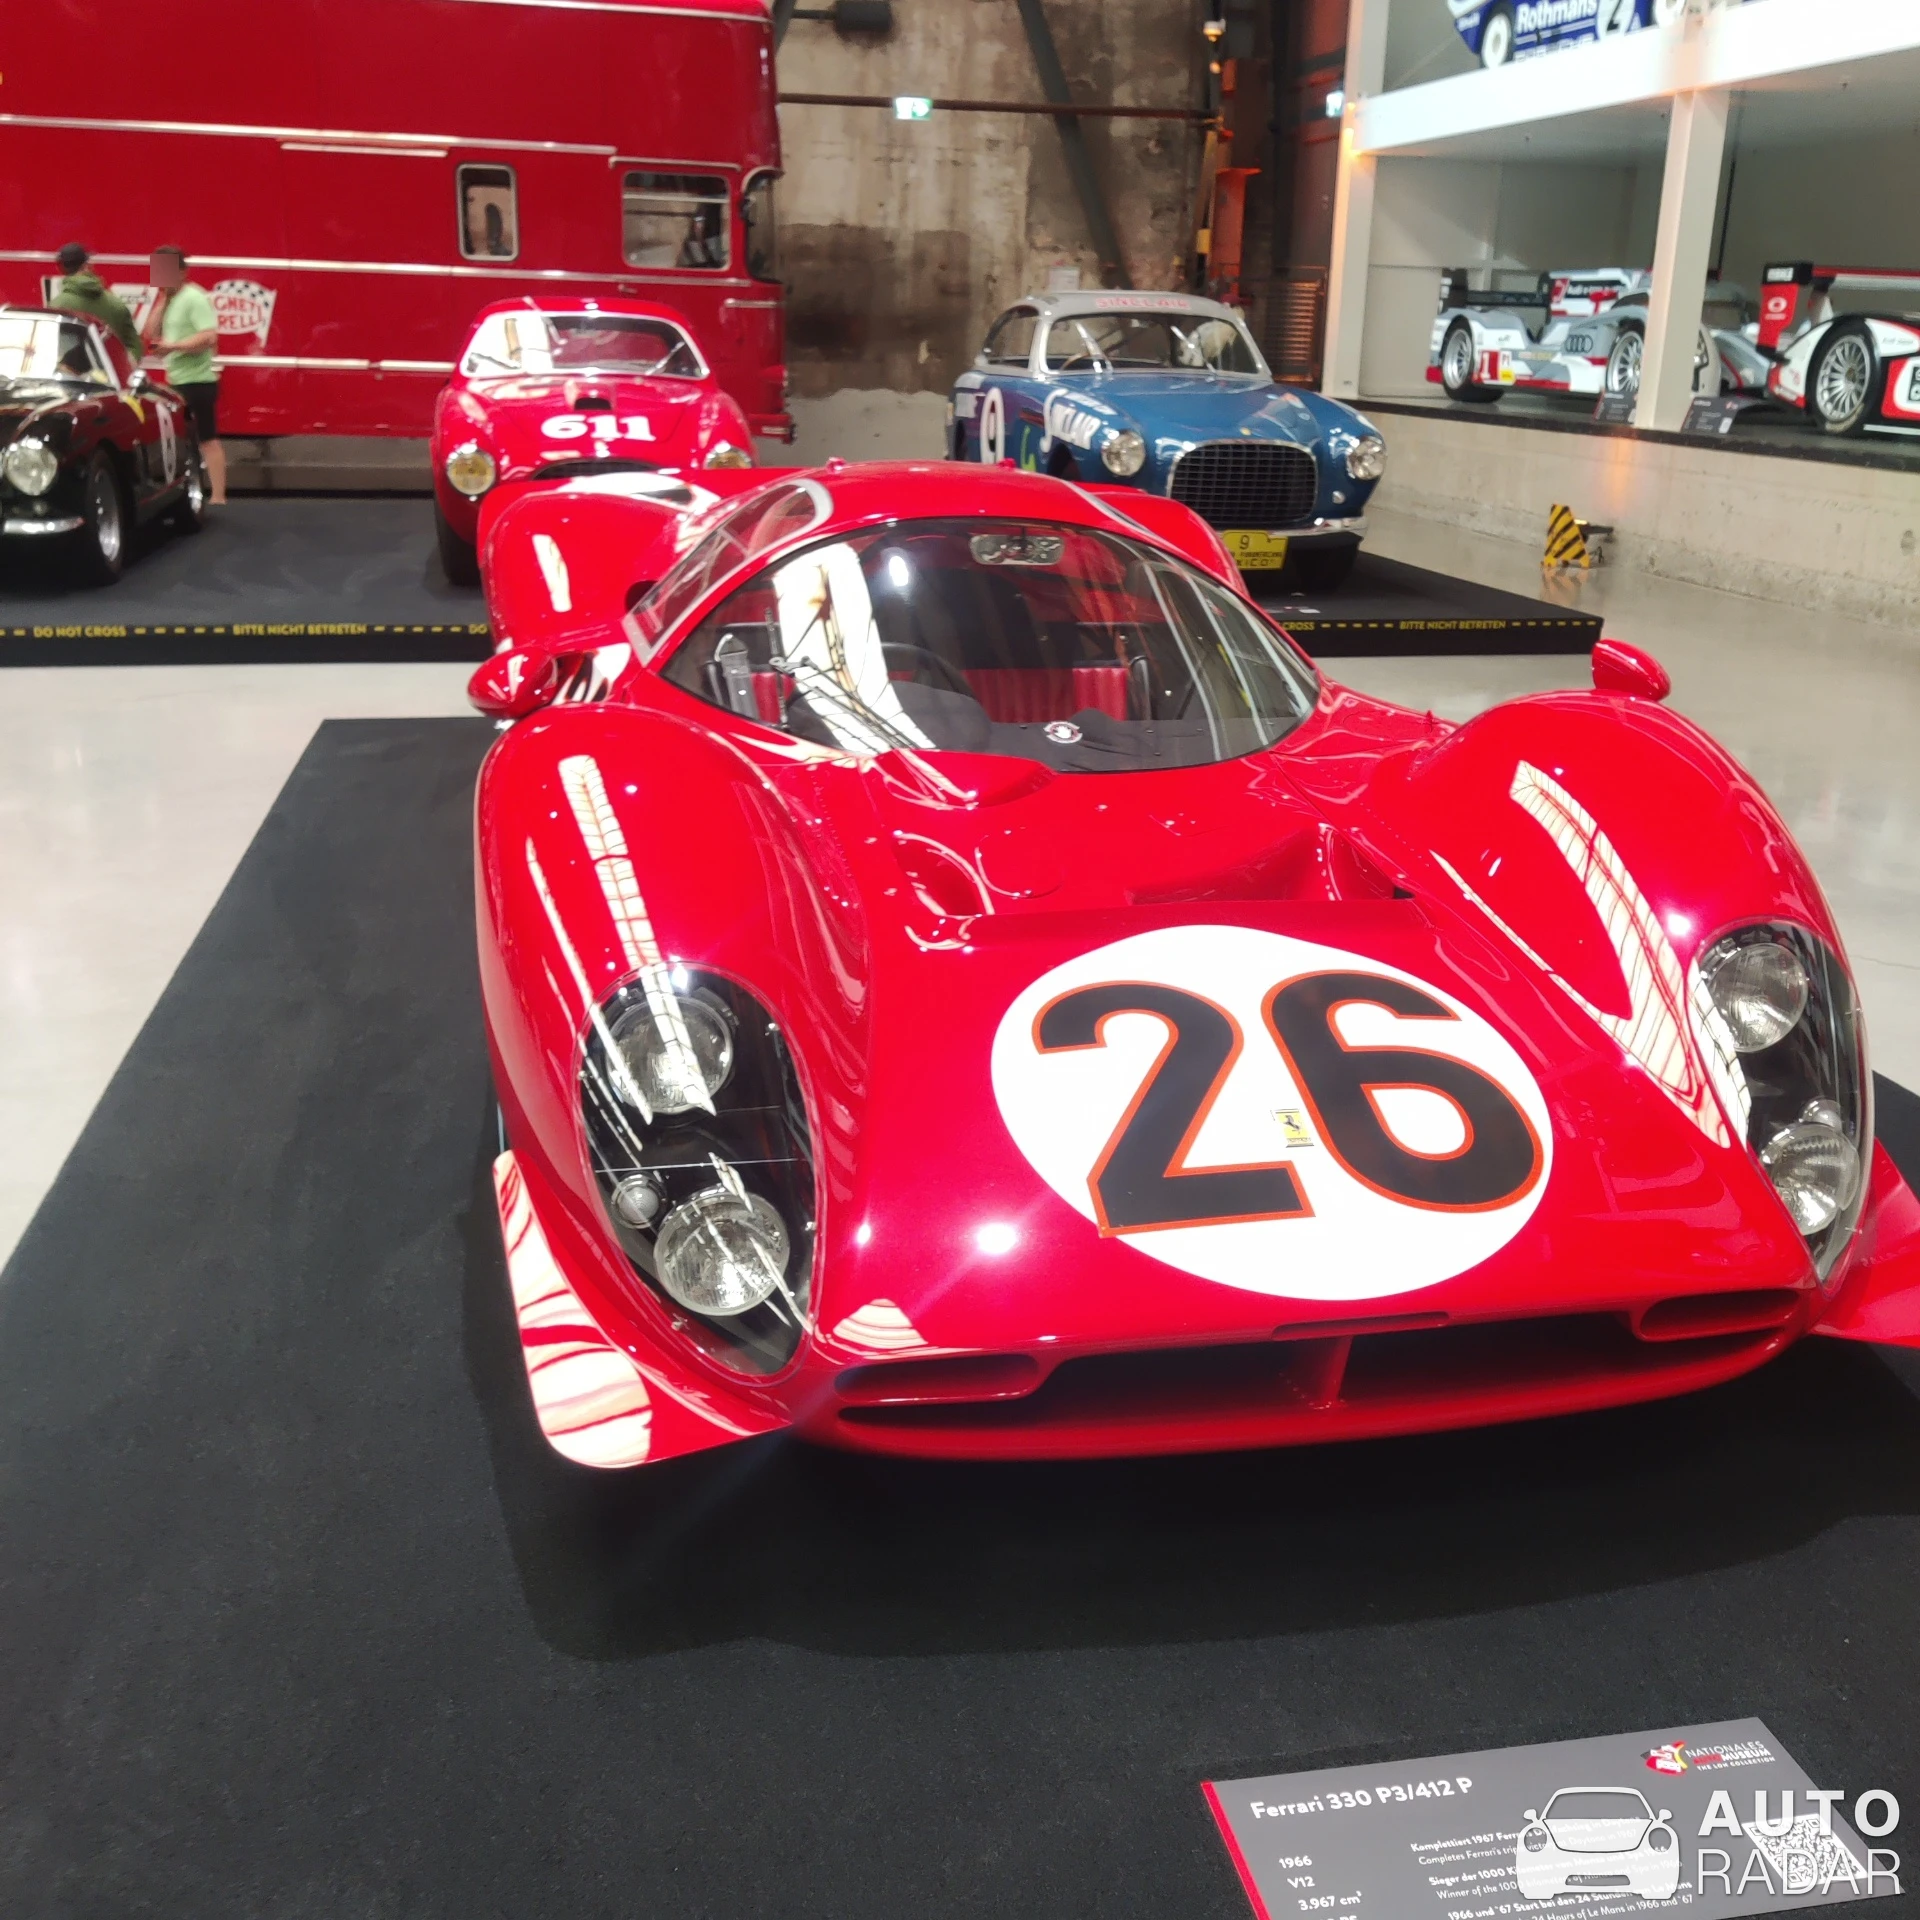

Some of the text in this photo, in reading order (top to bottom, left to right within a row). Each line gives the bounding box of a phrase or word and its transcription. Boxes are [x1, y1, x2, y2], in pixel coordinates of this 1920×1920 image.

[1516, 0, 1597, 33] Rothmans
[541, 414, 656, 441] 611
[1239, 534, 1250, 550] 9
[33, 626, 126, 638] DO NOT CROSS
[233, 625, 366, 635] BITTE NICHT BETRETEN
[469, 624, 487, 635] DO
[1283, 621, 1315, 630] CROSS
[1400, 620, 1506, 630] BITTE NICHT BETRETEN
[1031, 968, 1545, 1238] 26
[1685, 1741, 1764, 1758] NATIONALES
[1730, 1756, 1776, 1767] COLLECTION
[1250, 1777, 1473, 1819] Ferrari 330 P3/412 P
[1410, 1837, 1473, 1853] Komplettiert
[1471, 1833, 1495, 1844] 1967
[1279, 1855, 1312, 1869] 1966
[1418, 1851, 1466, 1866] Completes
[1287, 1876, 1315, 1889] V12
[1428, 1875, 1460, 1887] Sieger
[1461, 1871, 1477, 1882] der
[1477, 1868, 1506, 1879] 1000
[1436, 1889, 1470, 1900] Winner
[1472, 1885, 1481, 1897] of
[1483, 1884, 1498, 1894] the
[1298, 1895, 1335, 1911] 3.967
[1448, 1908, 1474, 1920] 1966
[1475, 1906, 1495, 1917] und
[1512, 1902, 1539, 1913] Start
[1539, 1899, 1555, 1909] bei
[1557, 1896, 1576, 1906] den
[1575, 1893, 1591, 1904] 24
[1577, 1908, 1587, 1920] of
[1588, 1907, 1599, 1917] Le
[1600, 1904, 1625, 1916] Mans
[1625, 1902, 1636, 1913] in
[1636, 1900, 1660, 1912] 1966
[1661, 1897, 1678, 1908] and
